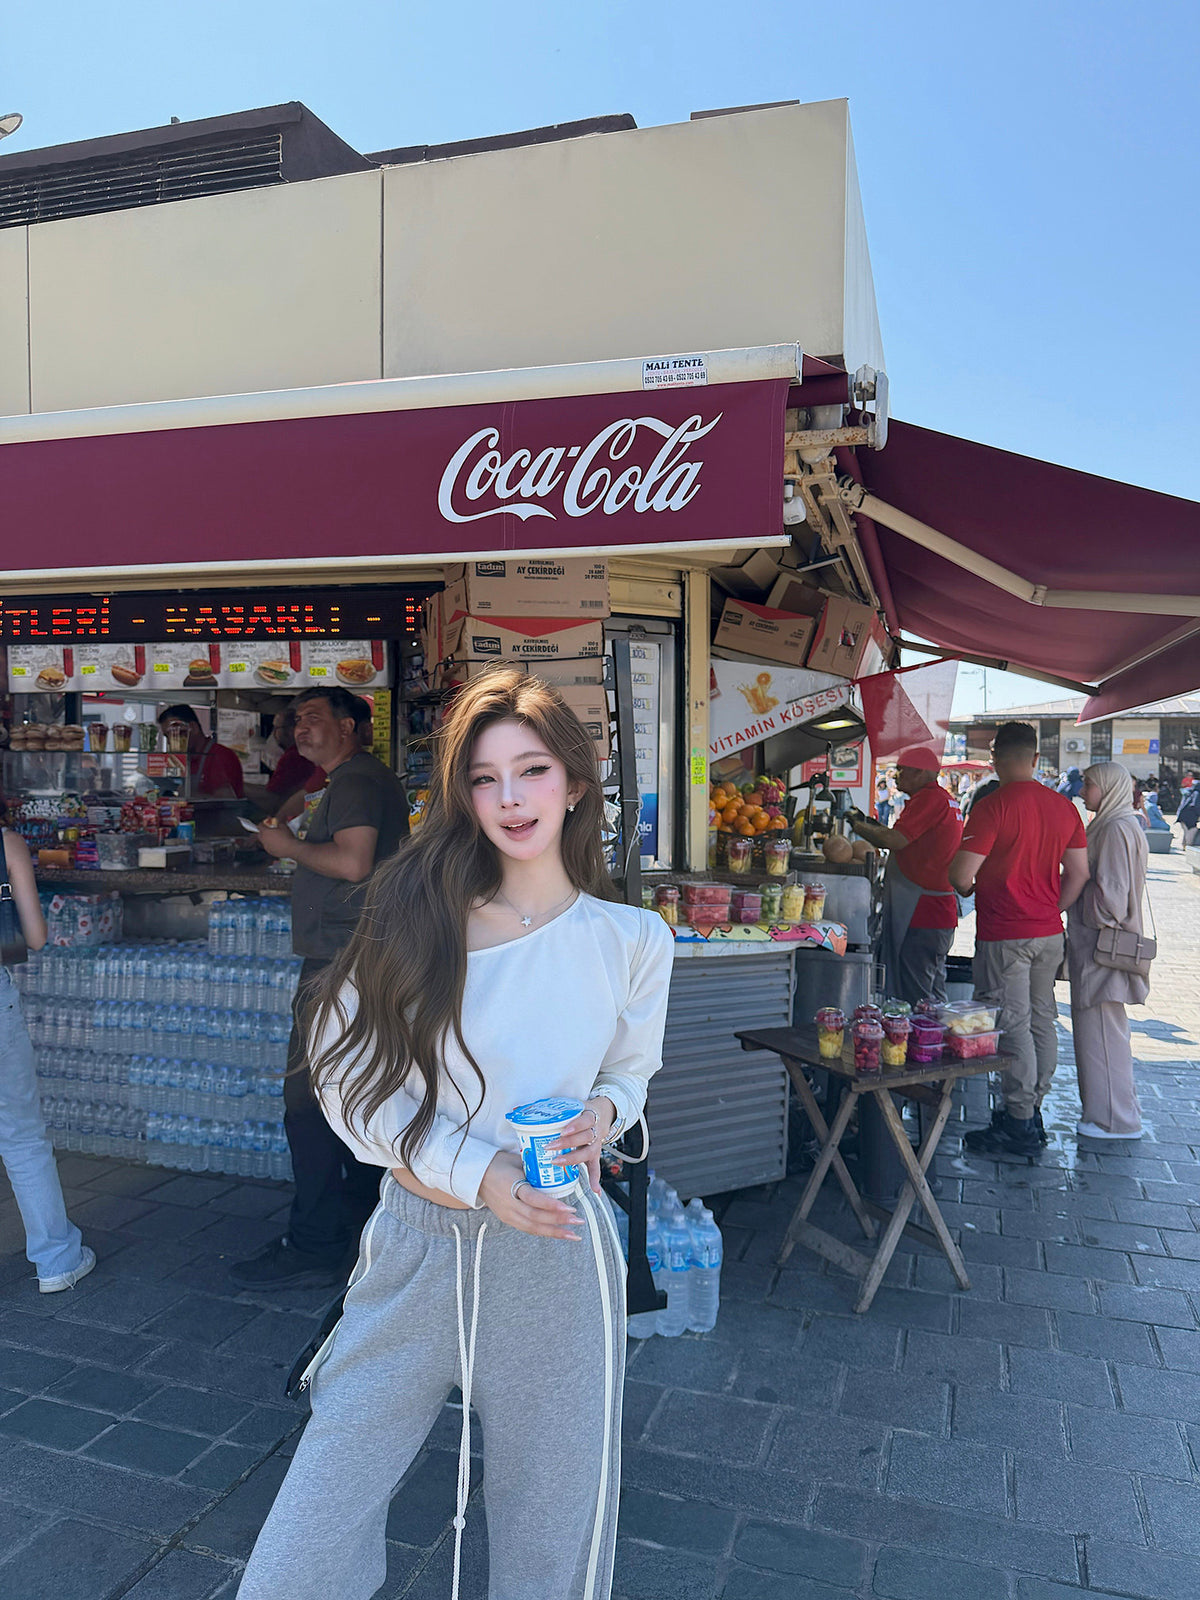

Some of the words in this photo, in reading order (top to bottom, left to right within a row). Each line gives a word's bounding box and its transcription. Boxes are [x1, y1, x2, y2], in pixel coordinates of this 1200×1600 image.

[672, 358, 704, 368] TENTE
[437, 411, 724, 524] Coca-Cola
[516, 566, 526, 574] AY
[527, 565, 565, 576] ÇEKİRDEĞİ
[512, 645, 521, 653] AY
[521, 644, 559, 654] ÇEKİRDEĞİ
[709, 718, 776, 754] VİTAMİN
